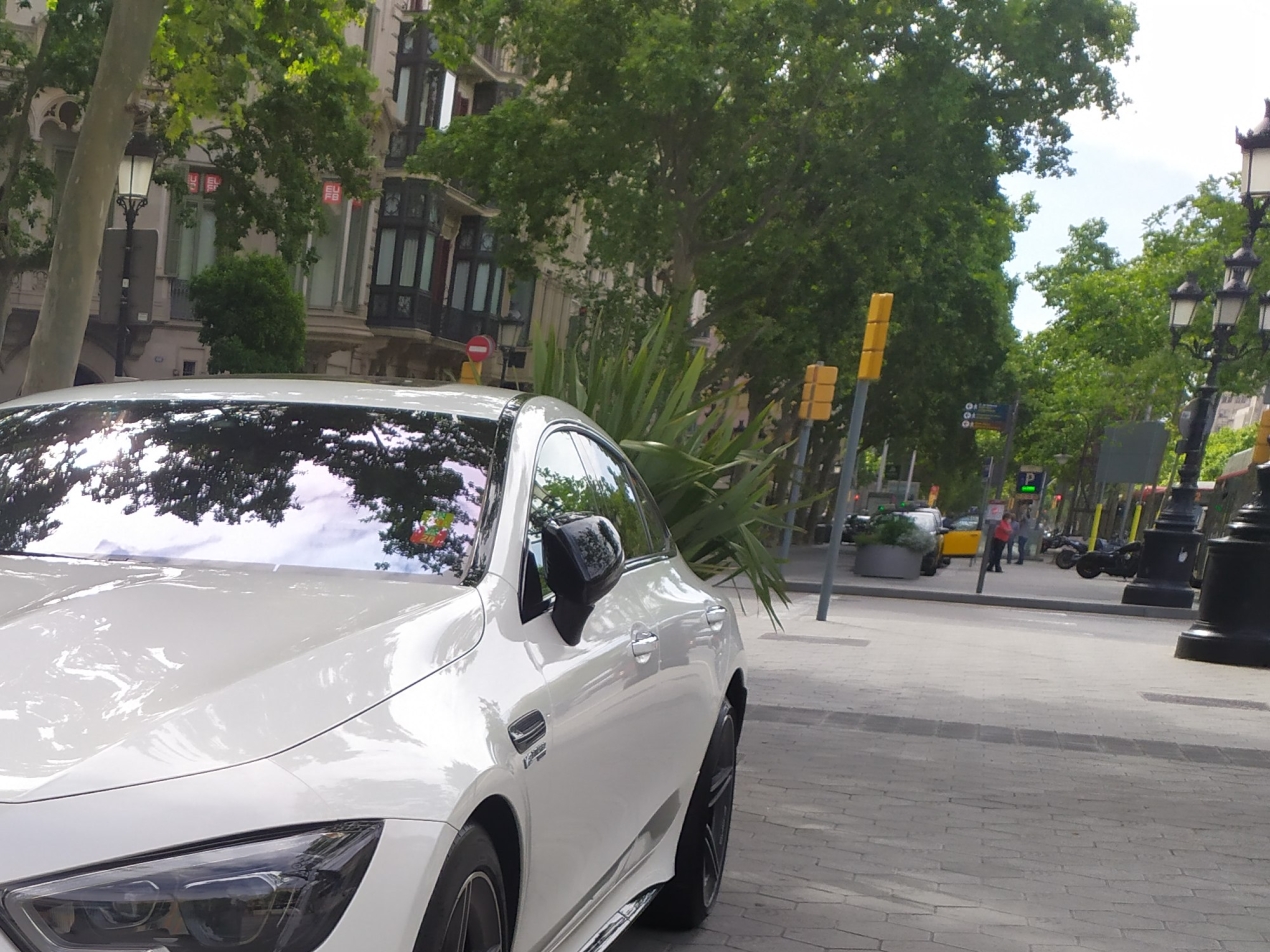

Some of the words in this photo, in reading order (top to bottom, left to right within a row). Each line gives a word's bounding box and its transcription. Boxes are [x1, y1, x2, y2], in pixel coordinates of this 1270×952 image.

[326, 185, 340, 193] EU
[324, 193, 339, 201] FB
[1025, 472, 1036, 486] P
